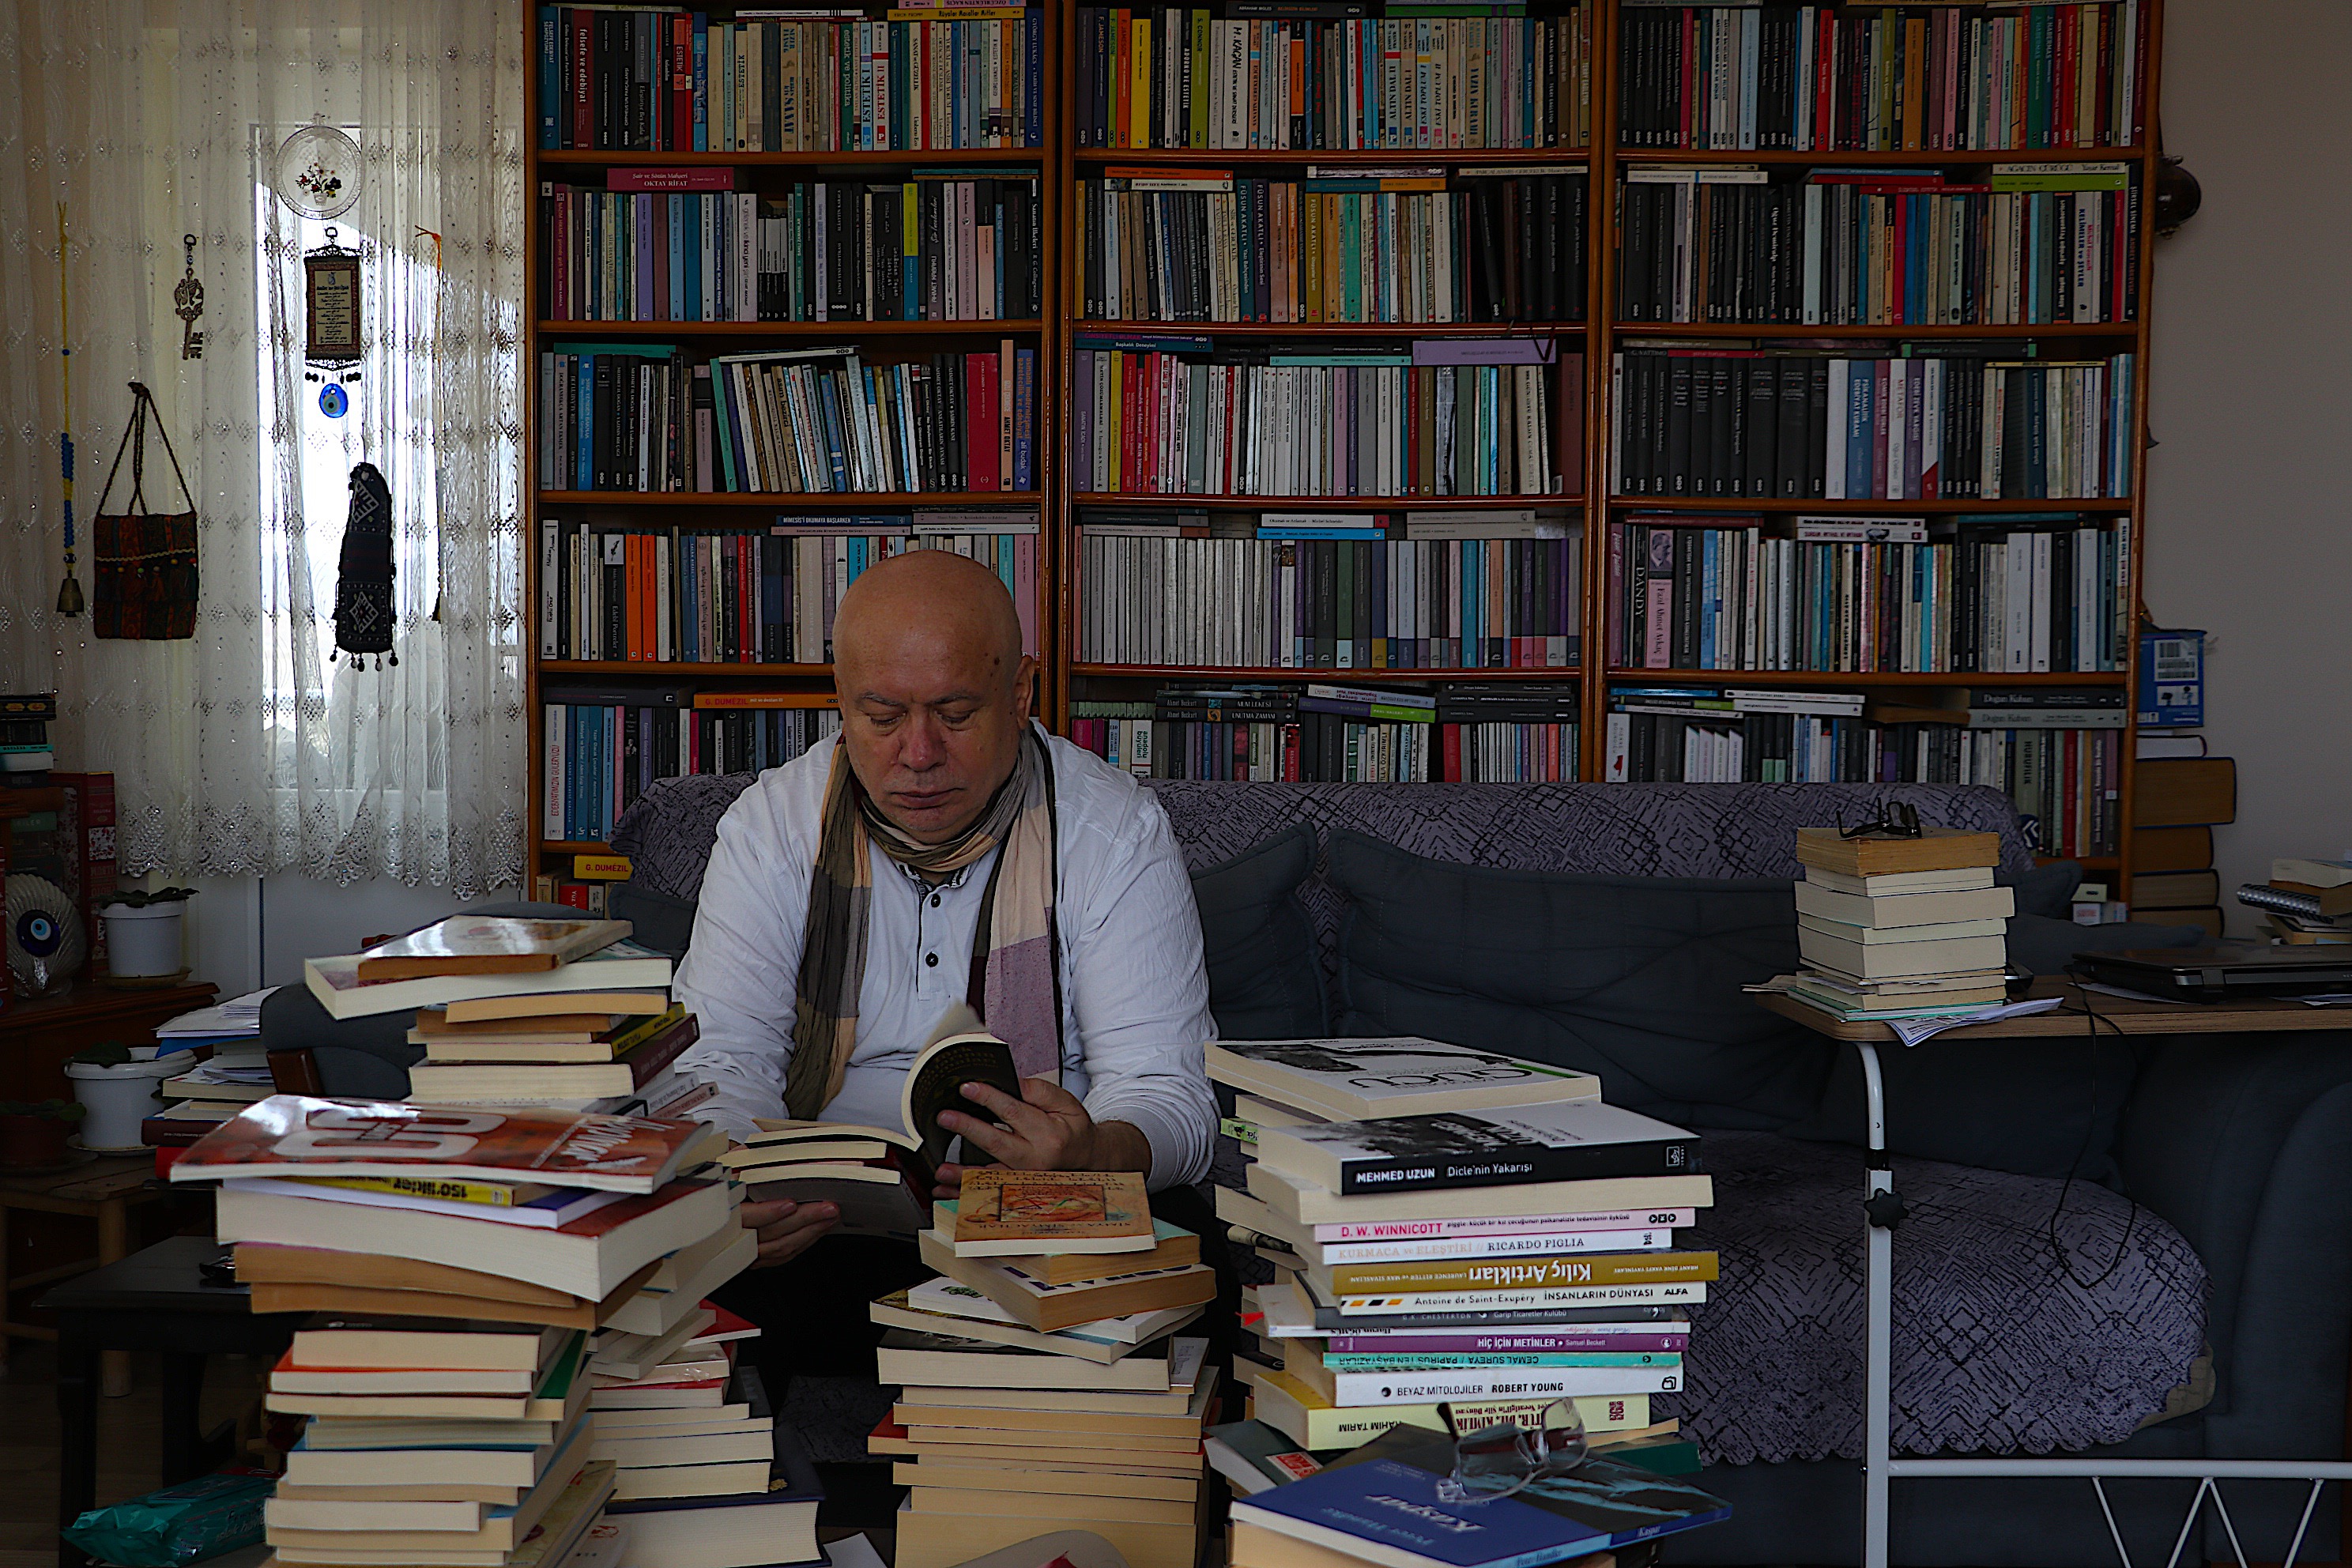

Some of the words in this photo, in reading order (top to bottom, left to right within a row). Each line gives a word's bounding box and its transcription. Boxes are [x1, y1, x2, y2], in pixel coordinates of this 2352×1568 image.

[579, 28, 588, 55] felsefe
[579, 68, 588, 103] edebiyat
[776, 379, 786, 398] asım
[778, 400, 790, 428] bezirci
[1634, 566, 1645, 618] DANDY
[1355, 1170, 1404, 1184] MEHMED
[1405, 1167, 1435, 1181] UZUN
[1446, 1165, 1491, 1178] Dicle'nin
[1492, 1163, 1533, 1175] Yakarışı
[1342, 1227, 1352, 1237] D.
[1357, 1226, 1371, 1236] W.
[1375, 1223, 1442, 1235] WINNICOTT
[1339, 1246, 1400, 1259] KURMACA
[1417, 1242, 1472, 1255] ELEŞTİRİ
[1488, 1239, 1542, 1251] RICARDO
[1545, 1238, 1585, 1249] PIGLIA
[1469, 1264, 1547, 1286] Artıkları
[1552, 1260, 1592, 1282] Kılıç
[1415, 1296, 1452, 1306] Antoine
[1456, 1295, 1466, 1304] de
[1544, 1289, 1606, 1301] İNSANLARIN
[1610, 1287, 1653, 1298] DÜNYASI
[1664, 1287, 1688, 1296] ALFA
[1477, 1336, 1492, 1349] HİÇ
[1494, 1336, 1512, 1349] İÇİN
[1513, 1335, 1556, 1348] METİNLER
[1510, 1355, 1540, 1364] CEMAL
[1397, 1386, 1425, 1396] BEYAZ
[1427, 1385, 1483, 1395] MİTOLOJİLER
[1492, 1383, 1527, 1393] ROBERT
[1531, 1382, 1563, 1393] YOUNG
[1340, 1423, 1369, 1433] TARIM
